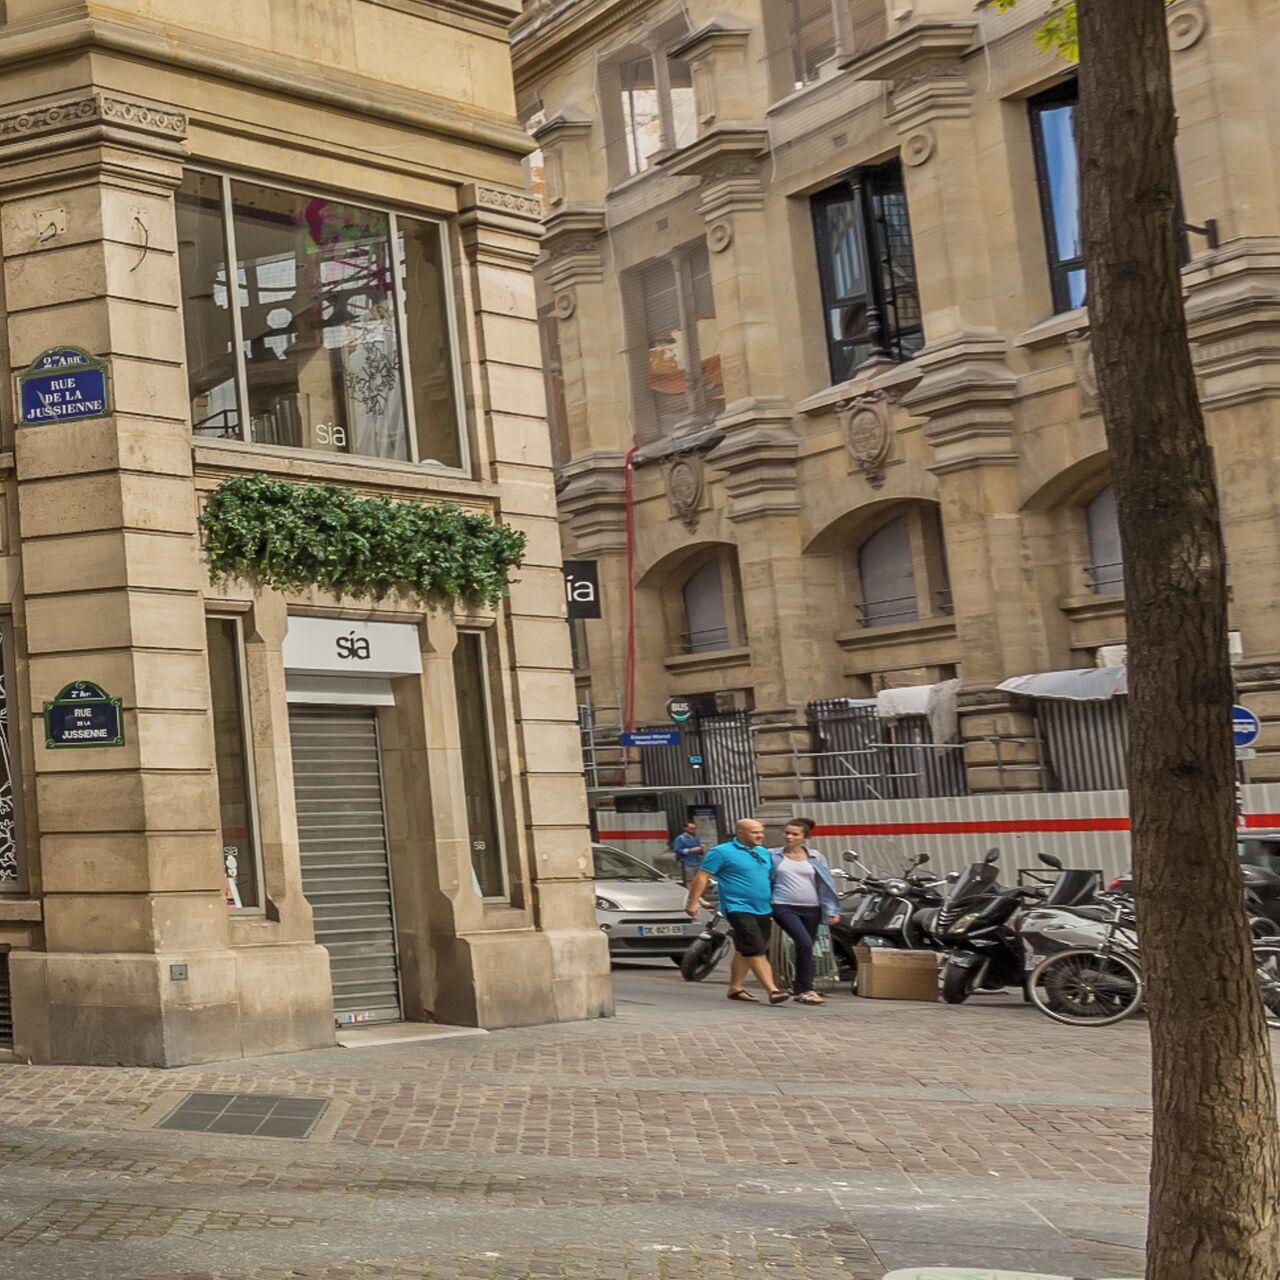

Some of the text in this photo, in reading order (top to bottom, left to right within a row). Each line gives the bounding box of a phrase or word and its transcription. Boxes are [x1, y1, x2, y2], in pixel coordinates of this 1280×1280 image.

[51, 378, 75, 390] RUE
[45, 390, 82, 403] DE LA
[27, 400, 102, 419] JUSSIENNE
[671, 703, 689, 711] BUS
[74, 708, 92, 718] RUE
[62, 729, 108, 739] JUSSIENNE
